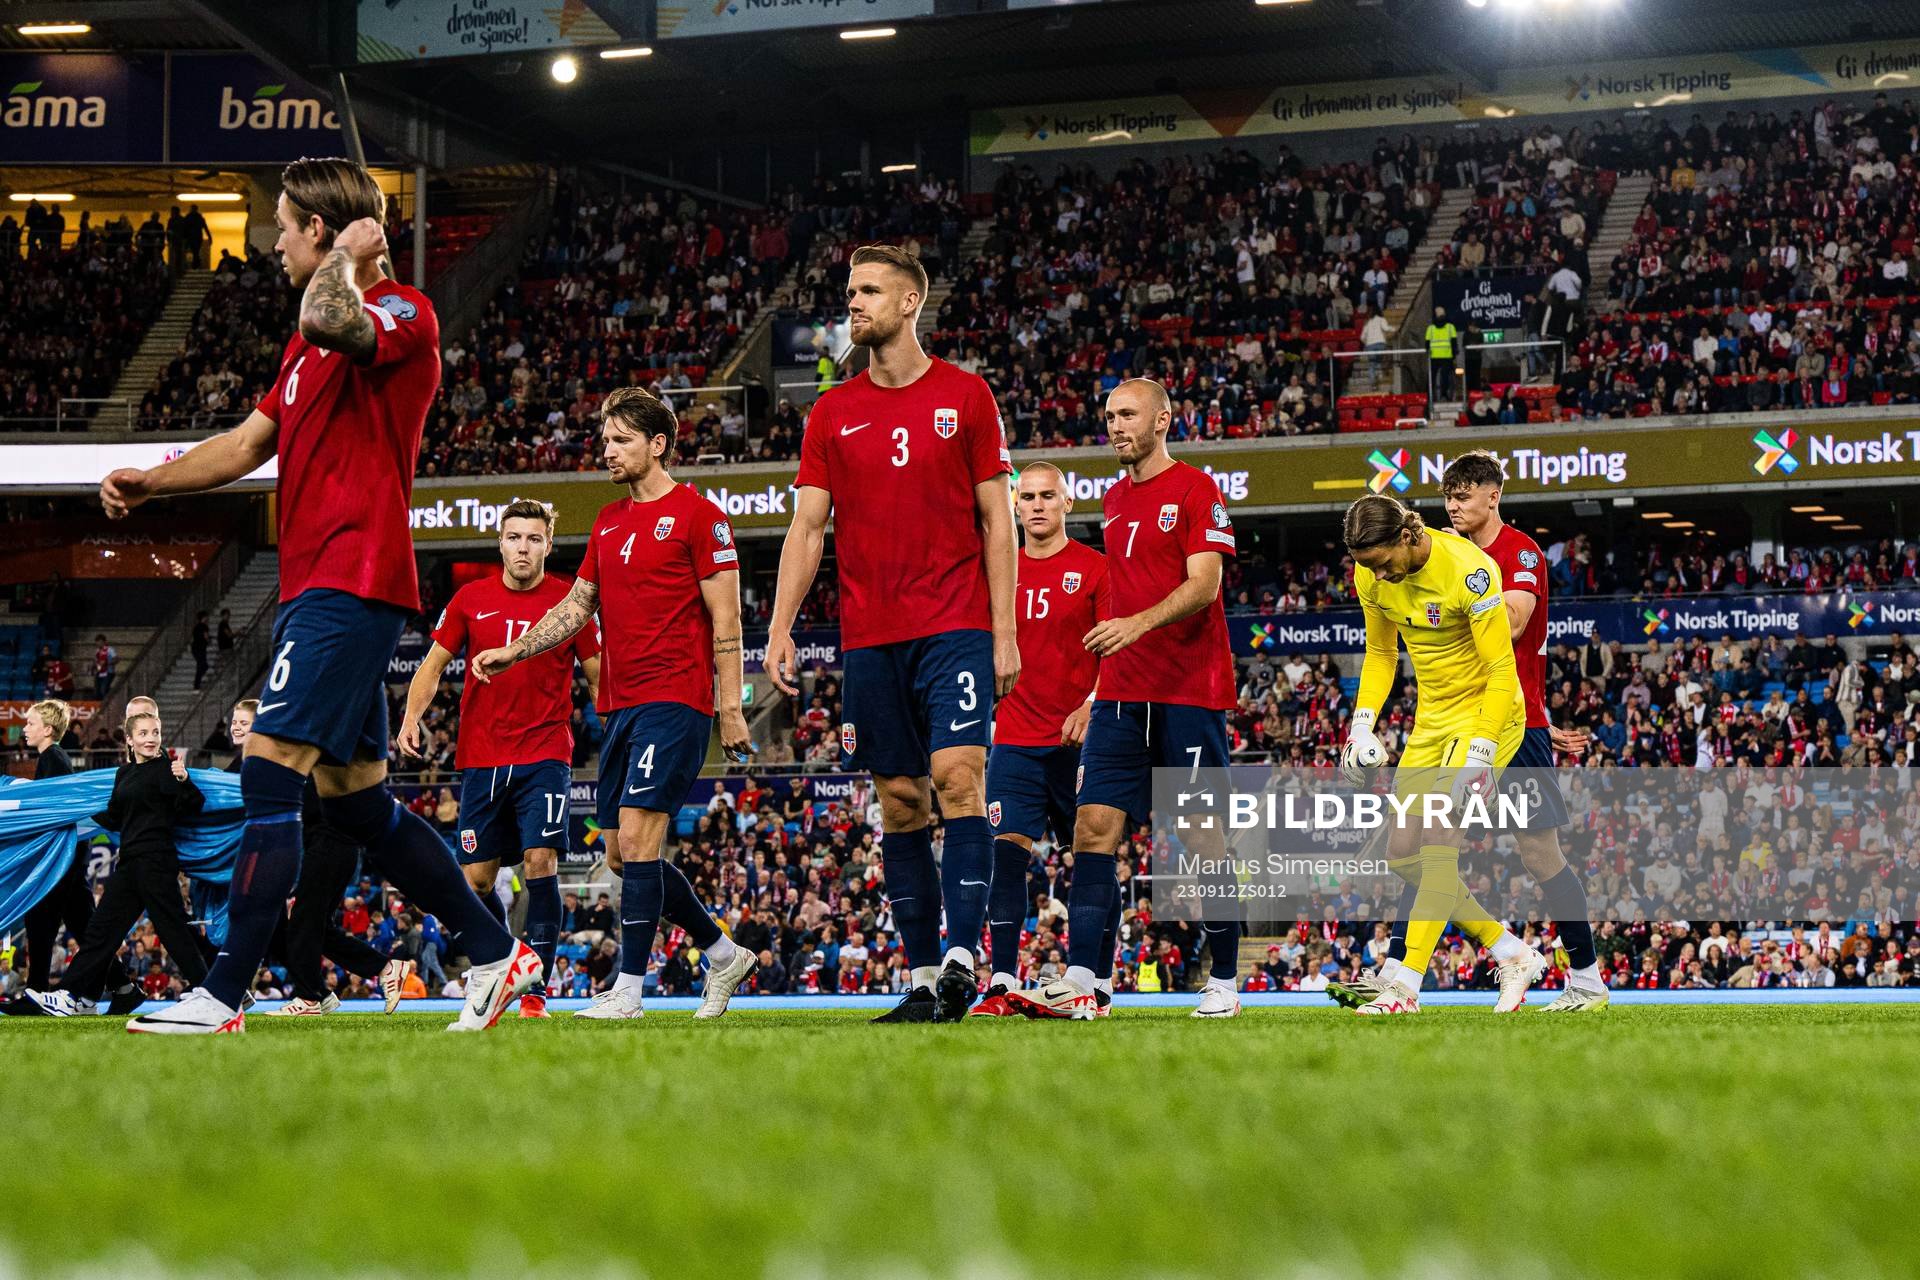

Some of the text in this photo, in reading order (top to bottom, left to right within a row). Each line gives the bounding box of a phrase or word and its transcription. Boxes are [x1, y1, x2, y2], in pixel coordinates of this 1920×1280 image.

[446, 3, 517, 35] drømmen
[460, 17, 529, 54] en sjanse!
[1597, 70, 1732, 96] Norsk Tipping
[1836, 54, 1858, 80] Gi
[0, 96, 107, 127] ama
[1054, 112, 1177, 135] Norsk Tipping
[1272, 97, 1294, 122] Gi
[1300, 94, 1373, 119] drømmen
[284, 355, 306, 406] 6
[891, 426, 909, 467] 3
[1808, 432, 1904, 466] Norsk
[1512, 446, 1627, 483] Tipping
[619, 532, 636, 564] 4
[1125, 521, 1140, 558] 7
[1026, 588, 1050, 619] 15
[505, 619, 531, 648] 17
[1280, 625, 1331, 644] Norsk
[1675, 609, 1799, 631] Norsk Tipping
[269, 640, 296, 692] 6
[957, 671, 977, 711] 3
[637, 744, 655, 778] 4
[1185, 746, 1202, 784] 7
[1445, 738, 1460, 767] 1
[544, 793, 566, 824] 17
[1508, 777, 1542, 812] 23
